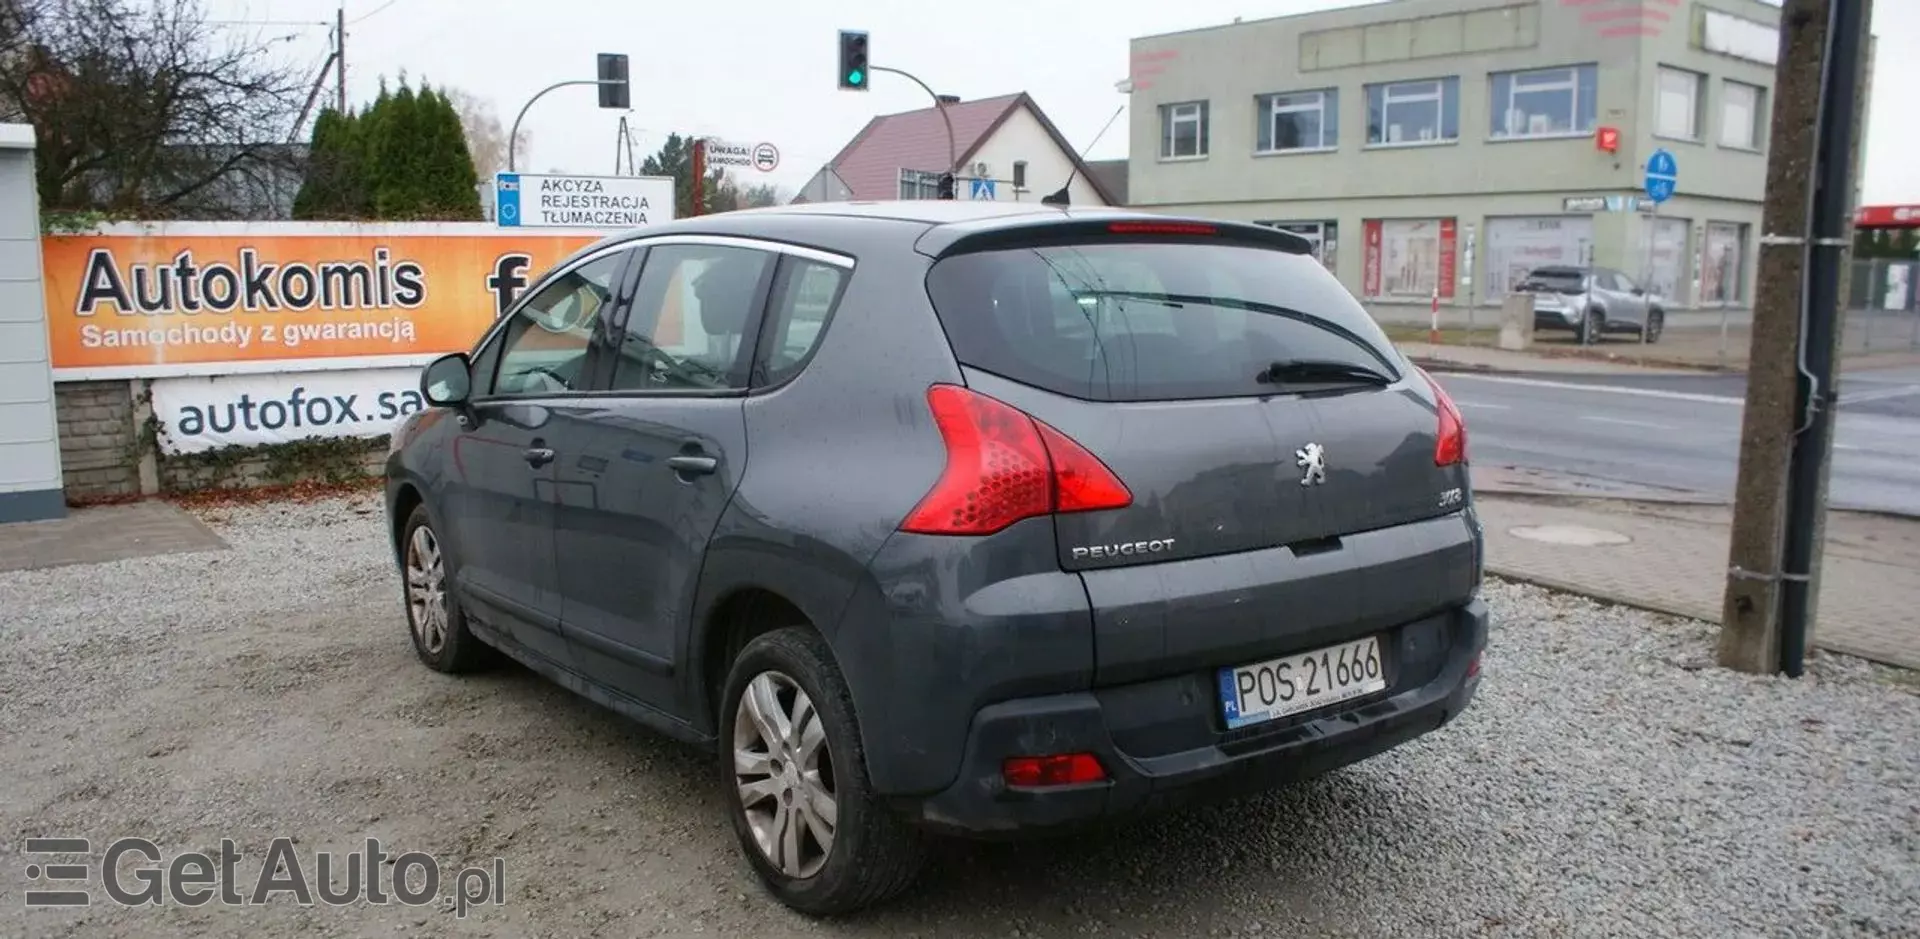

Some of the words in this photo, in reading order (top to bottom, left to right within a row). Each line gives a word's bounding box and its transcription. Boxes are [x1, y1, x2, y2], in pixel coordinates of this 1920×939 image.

[541, 179, 604, 193] AKCYZA
[541, 195, 650, 209] REJESTRACJA
[542, 211, 649, 225] TŁUMACZENIA
[77, 247, 425, 315] Autokomis
[82, 324, 252, 348] Samochody
[261, 326, 276, 342] z
[284, 318, 416, 345] gwarancją
[1072, 538, 1175, 560] PEUGEOT
[1236, 662, 1296, 712] POS
[1302, 640, 1378, 697] 21666
[1225, 701, 1237, 712] PL
